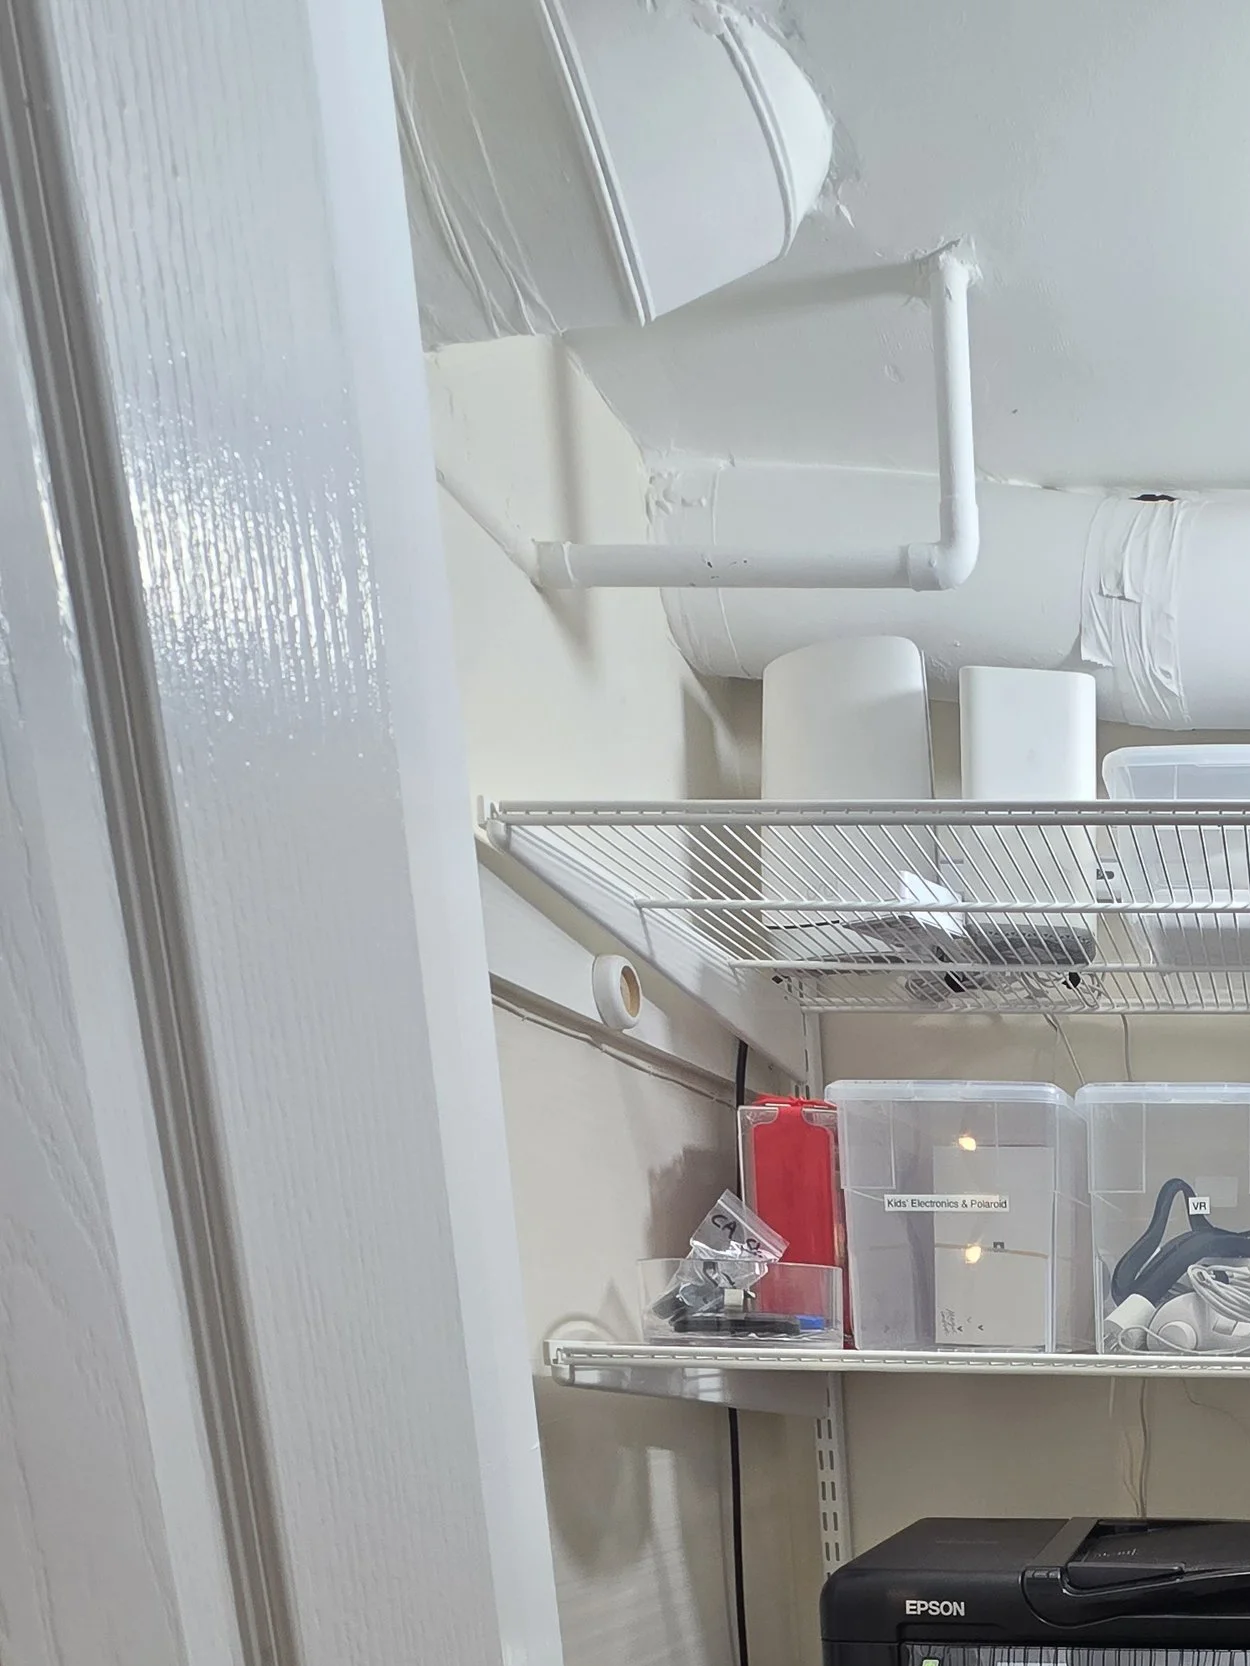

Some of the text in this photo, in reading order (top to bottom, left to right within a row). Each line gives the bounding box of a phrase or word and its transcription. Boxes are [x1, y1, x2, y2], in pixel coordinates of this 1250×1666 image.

[887, 1198, 1008, 1209] Kids' Electronics & Polaroid
[1192, 1201, 1207, 1211] VR
[905, 1600, 966, 1617] EPSON
